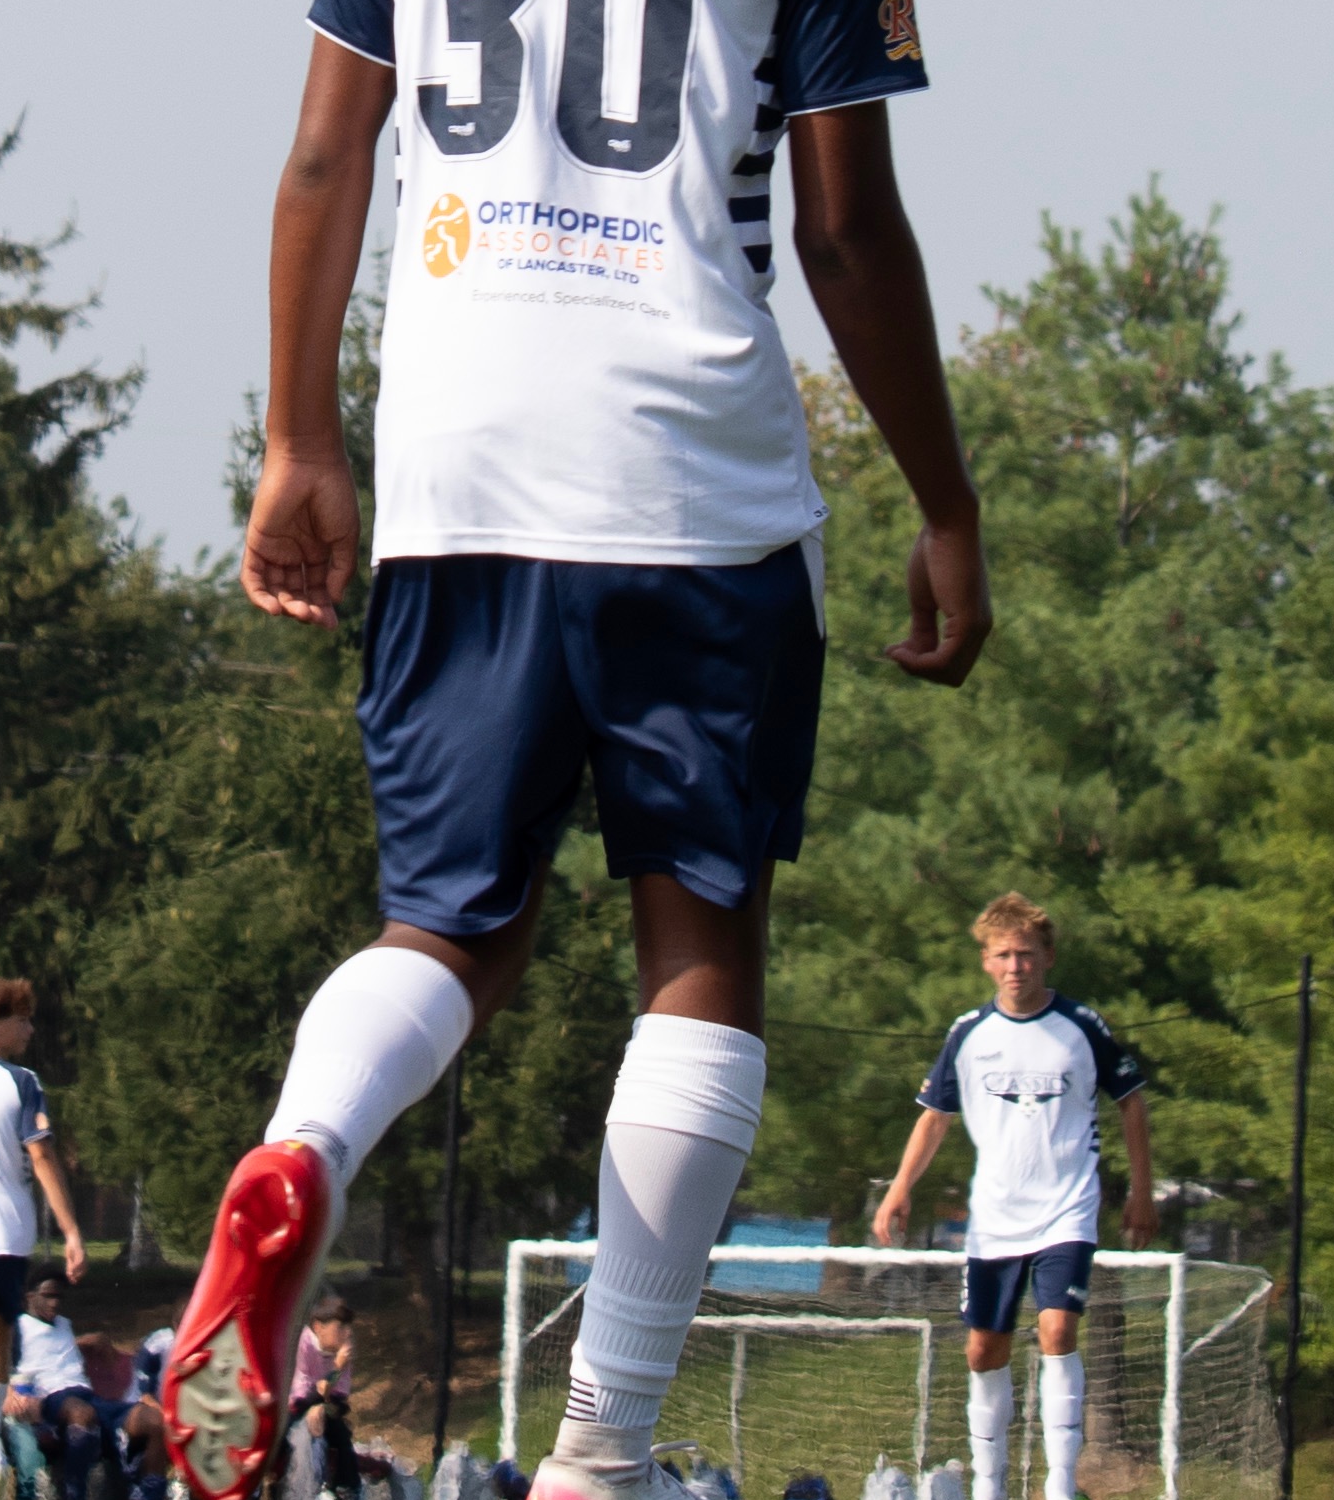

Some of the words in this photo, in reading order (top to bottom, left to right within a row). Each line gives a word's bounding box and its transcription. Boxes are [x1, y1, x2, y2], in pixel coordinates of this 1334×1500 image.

[478, 200, 664, 245] ORTHOPEDIC
[476, 231, 664, 271] ASSOCIATES
[497, 258, 514, 269] OF
[517, 258, 611, 280] LANCASTER,
[614, 271, 640, 285] LTD
[554, 291, 635, 312] Specialized
[639, 303, 671, 320] Care
